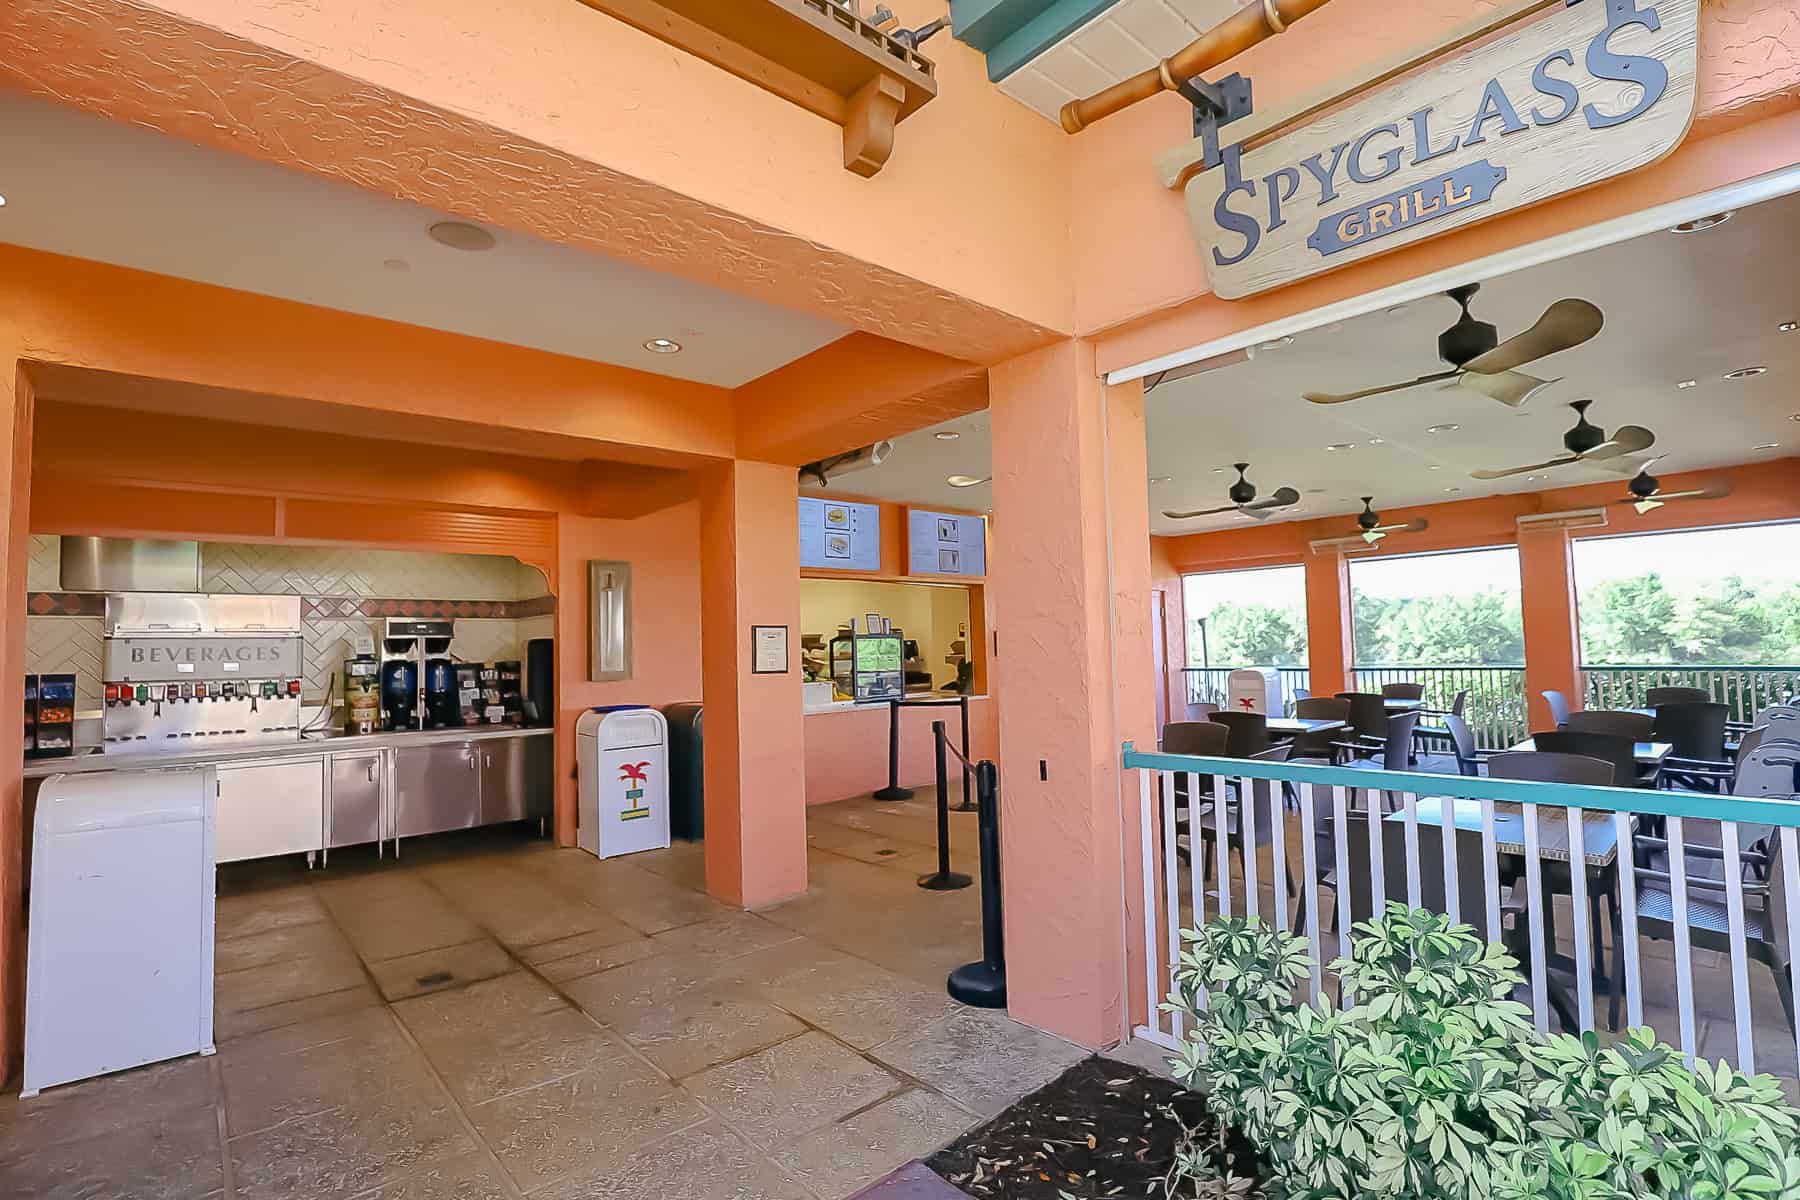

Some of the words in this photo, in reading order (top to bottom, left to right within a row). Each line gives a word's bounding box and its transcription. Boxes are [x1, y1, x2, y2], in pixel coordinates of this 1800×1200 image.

[1212, 14, 1669, 266] SPYGLASS
[1336, 178, 1473, 243] GRILL
[130, 646, 281, 664] BEVERAGES
